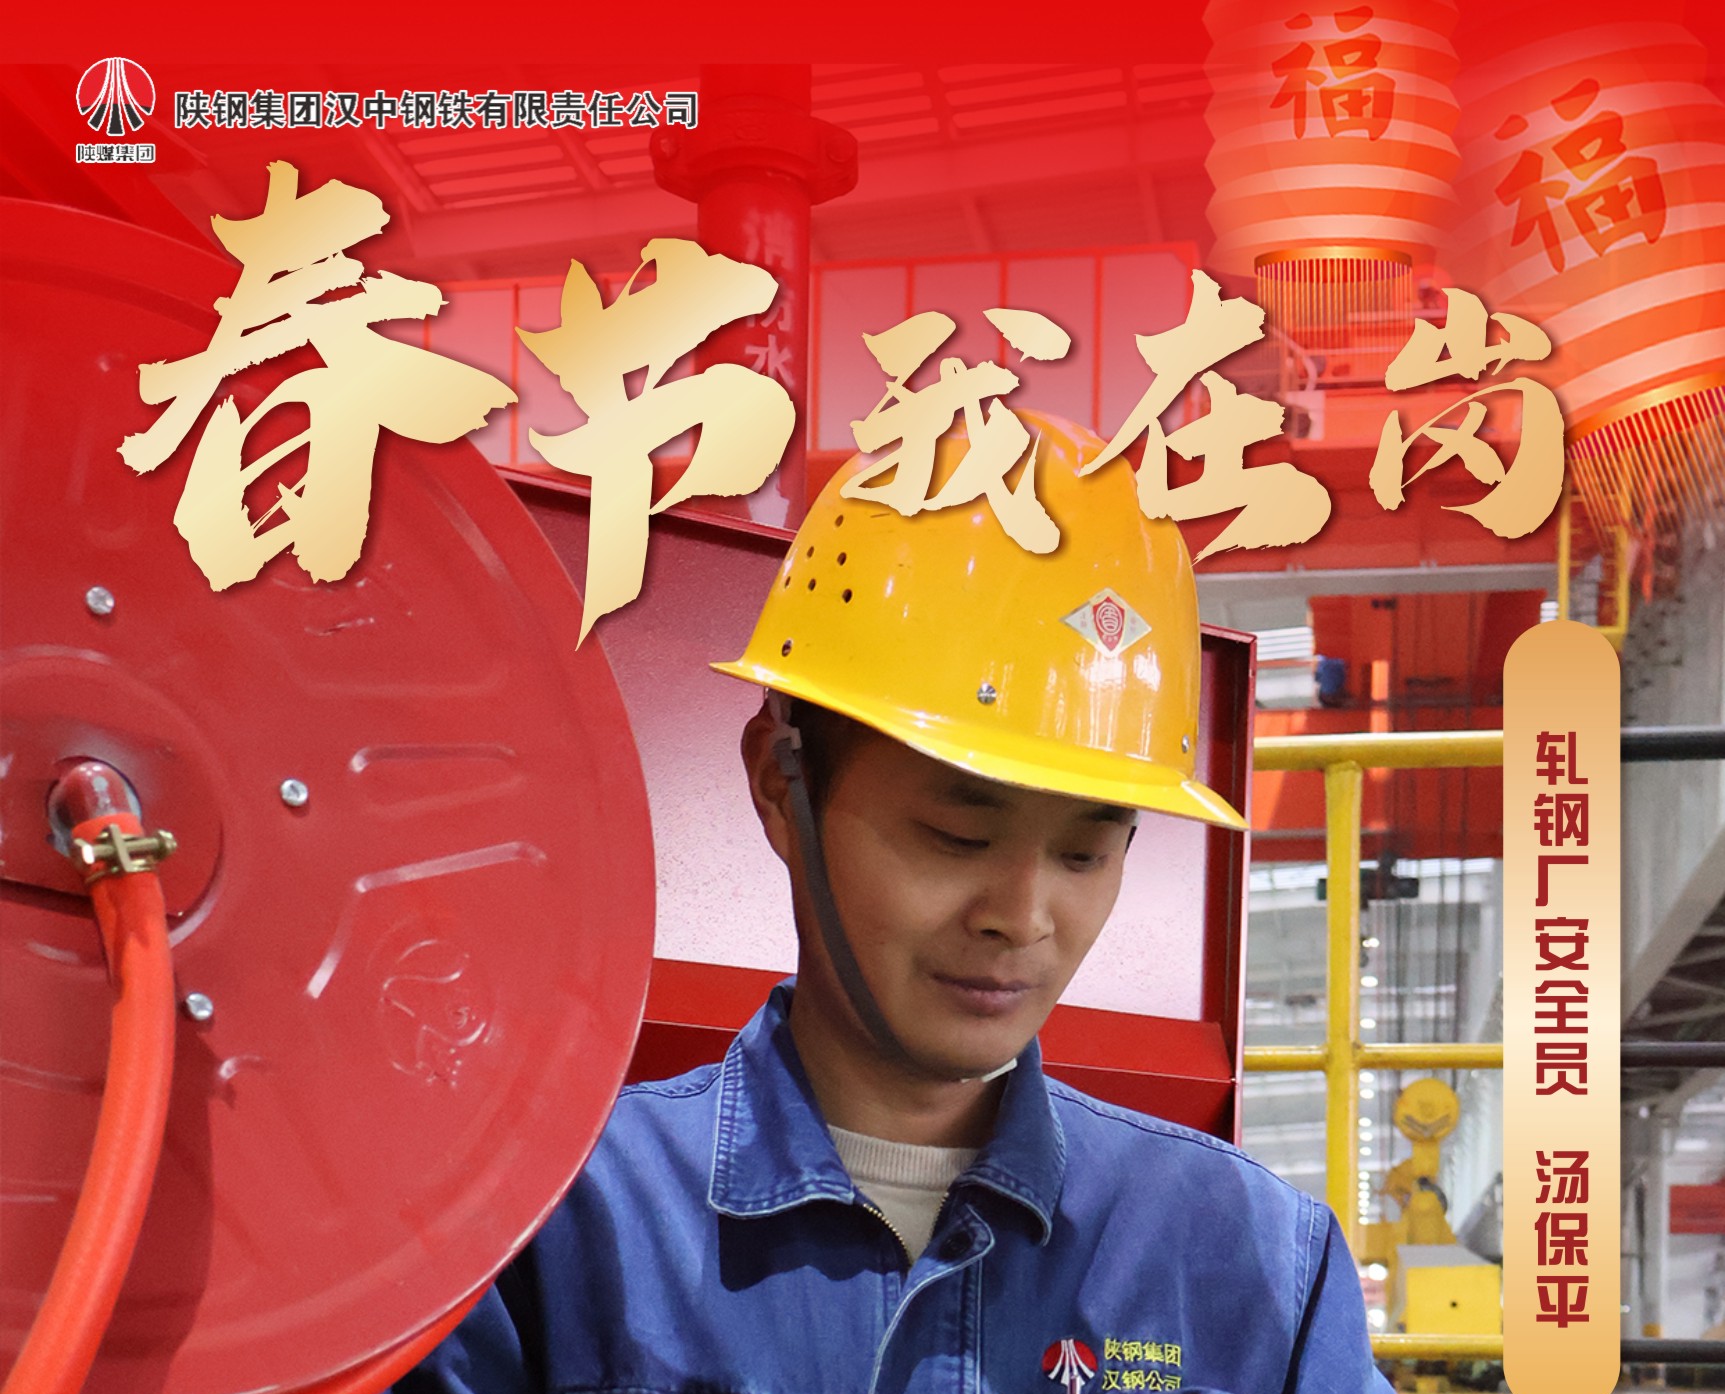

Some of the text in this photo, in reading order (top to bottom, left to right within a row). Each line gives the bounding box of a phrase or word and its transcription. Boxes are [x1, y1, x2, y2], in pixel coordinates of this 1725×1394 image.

[1104, 1338, 1182, 1367] 陕钢集团
[1102, 1369, 1182, 1391] 汉钢公司
